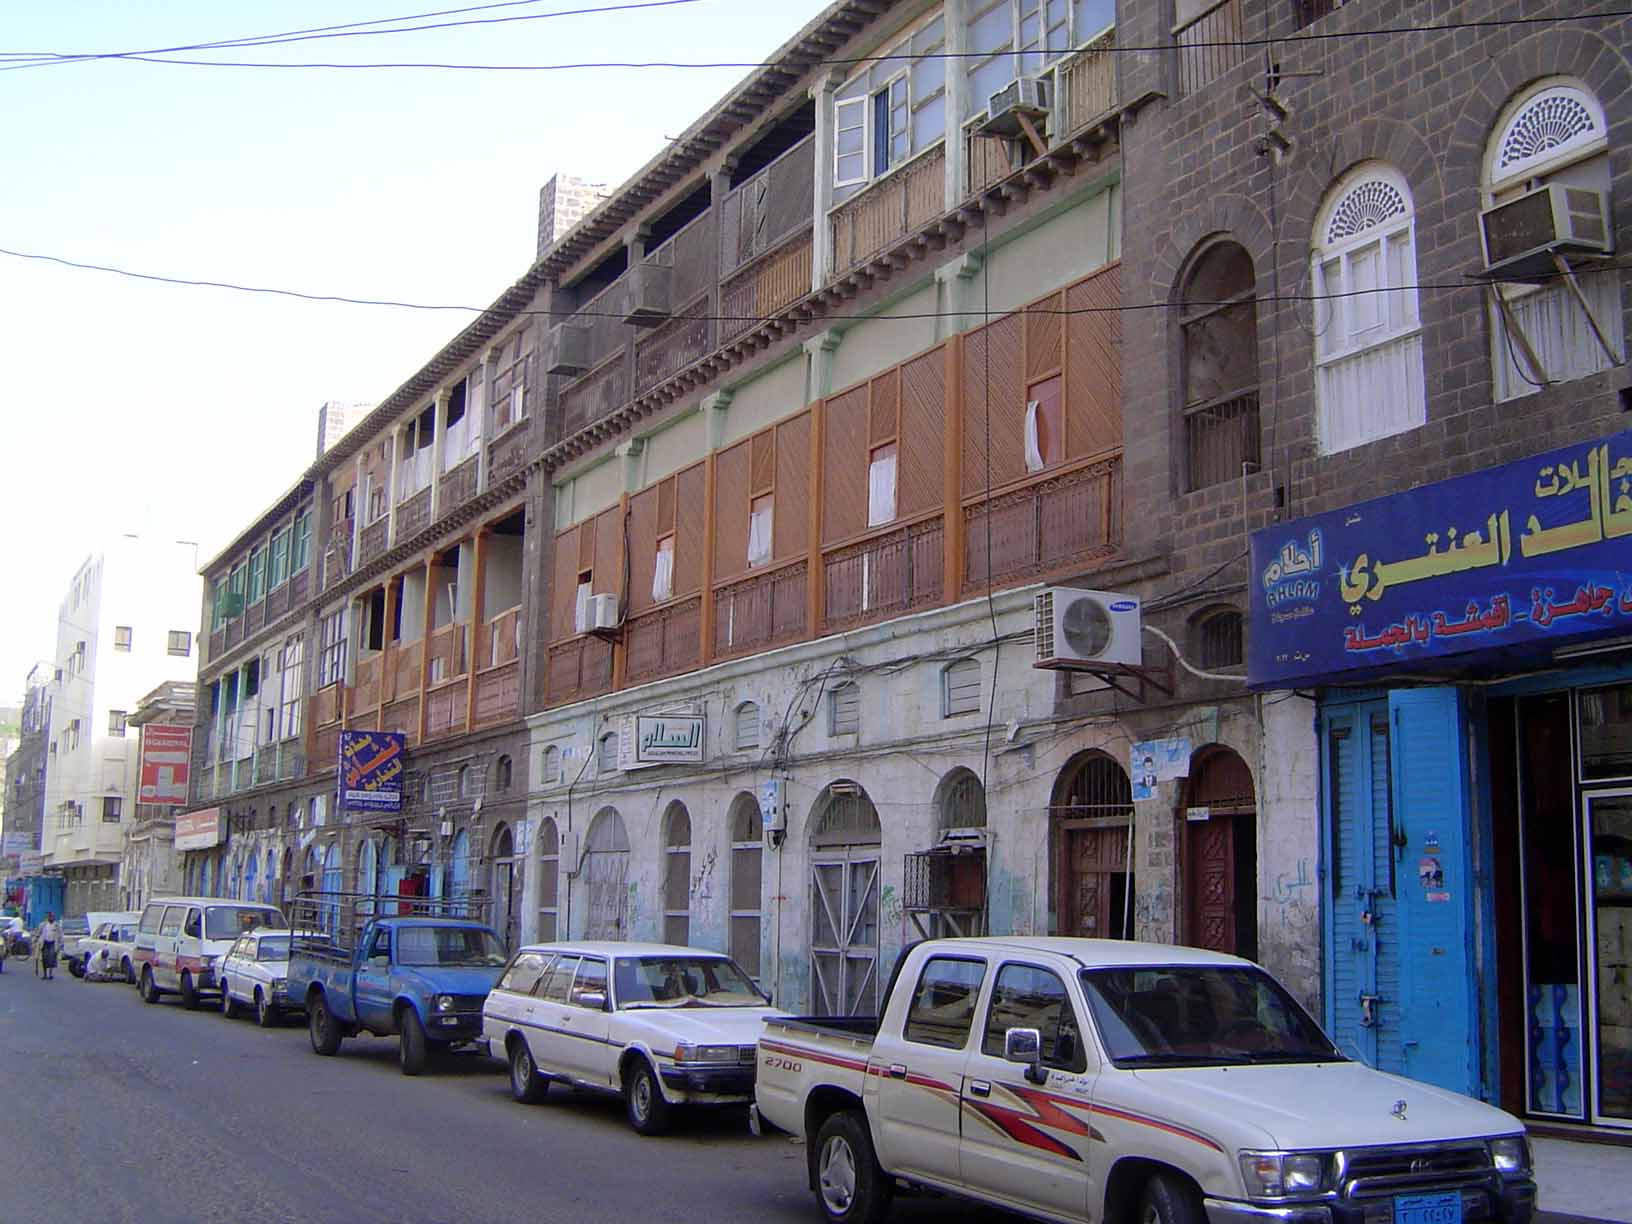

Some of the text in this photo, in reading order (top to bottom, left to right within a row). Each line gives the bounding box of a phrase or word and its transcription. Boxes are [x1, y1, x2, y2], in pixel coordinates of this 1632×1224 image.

[1264, 529, 1321, 587] أحلام
[1340, 510, 1511, 615] العنتري
[1266, 580, 1320, 607] AHLAM
[1532, 583, 1615, 626] جاهزة
[1345, 617, 1430, 651] بالجملة
[765, 1056, 802, 1072] 2700
